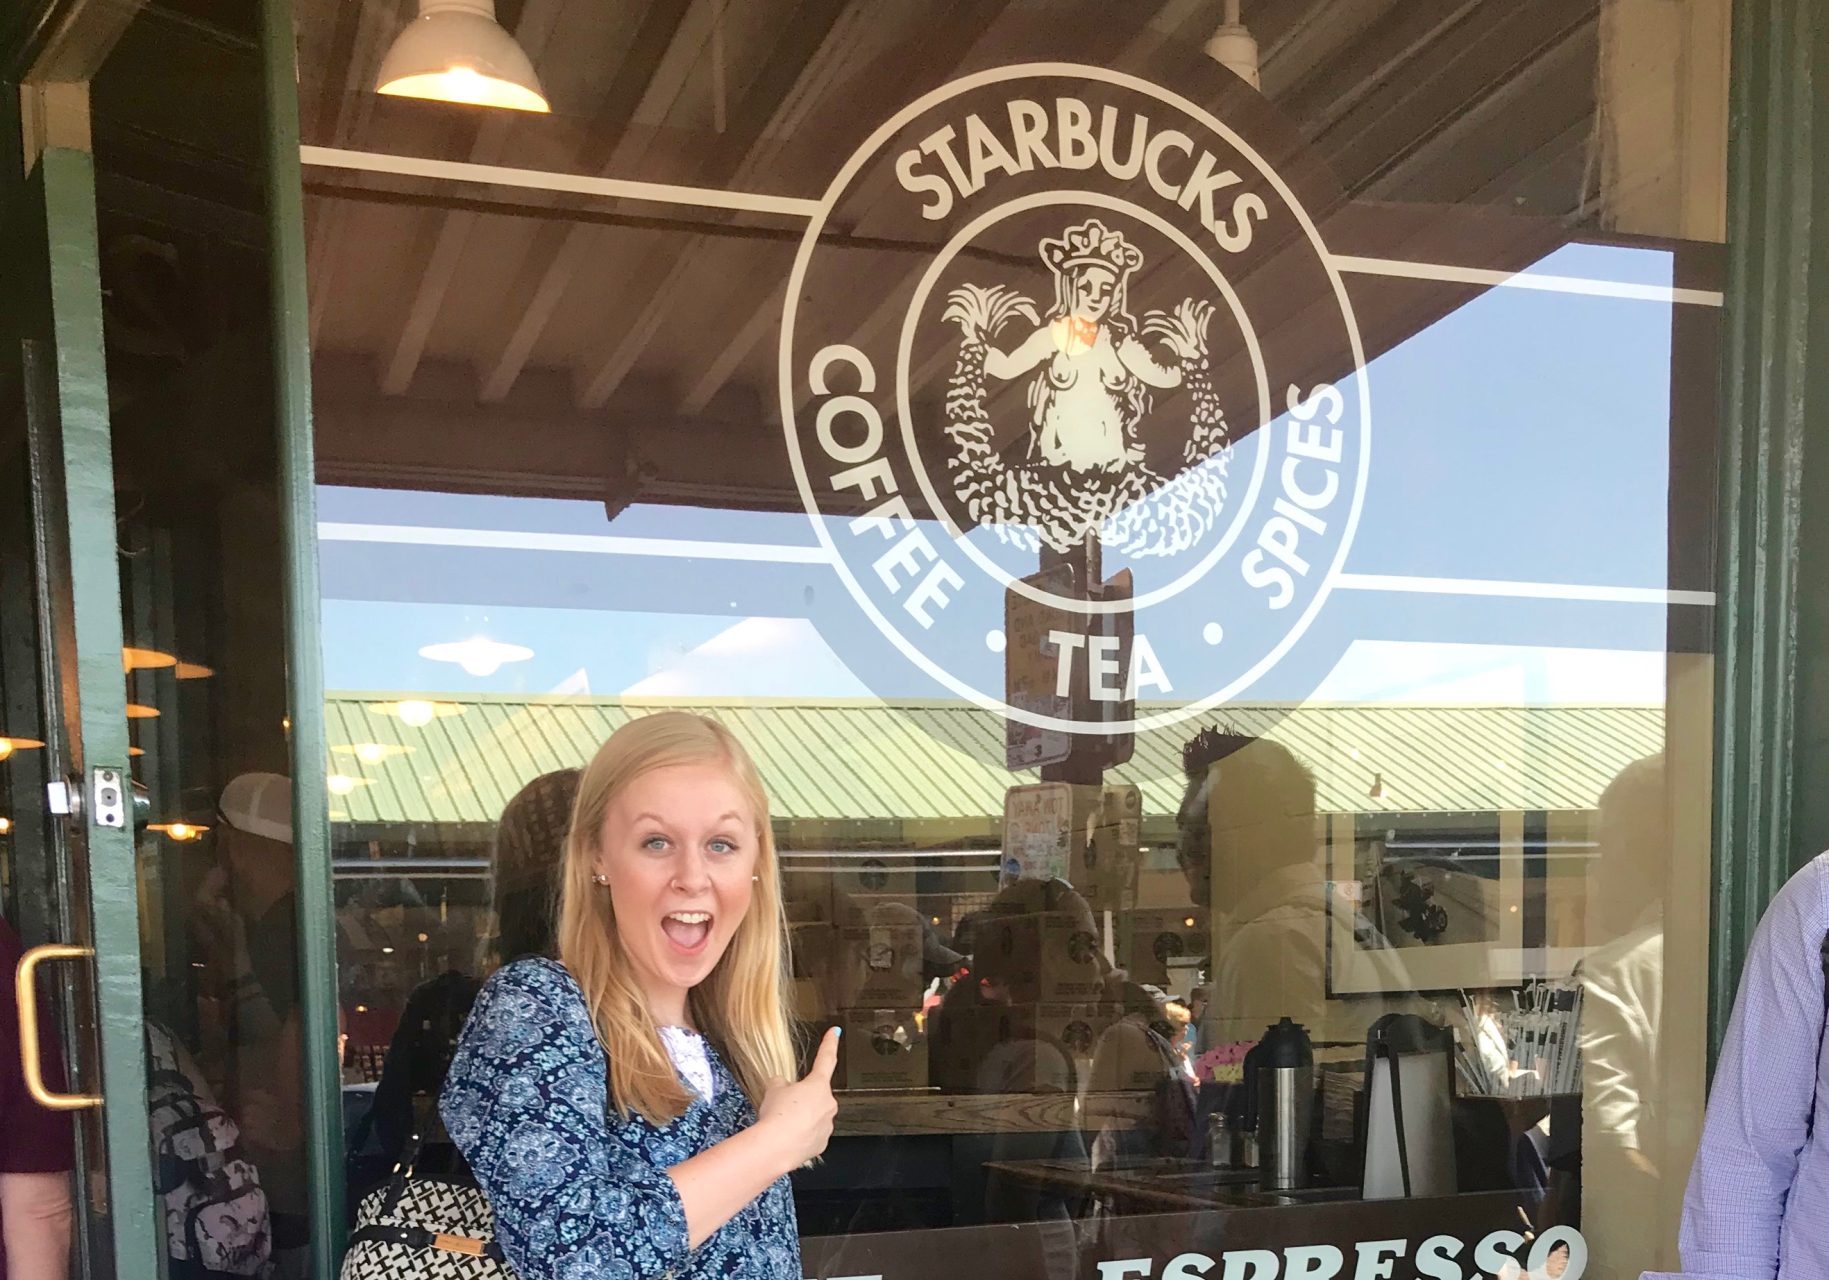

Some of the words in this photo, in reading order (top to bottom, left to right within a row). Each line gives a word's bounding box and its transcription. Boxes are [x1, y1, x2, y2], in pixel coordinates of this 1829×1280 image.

[895, 98, 1267, 253] STARBUCKS
[809, 344, 965, 630] COFFEE
[1240, 383, 1344, 609] SPICES
[1049, 630, 1172, 702] TEA
